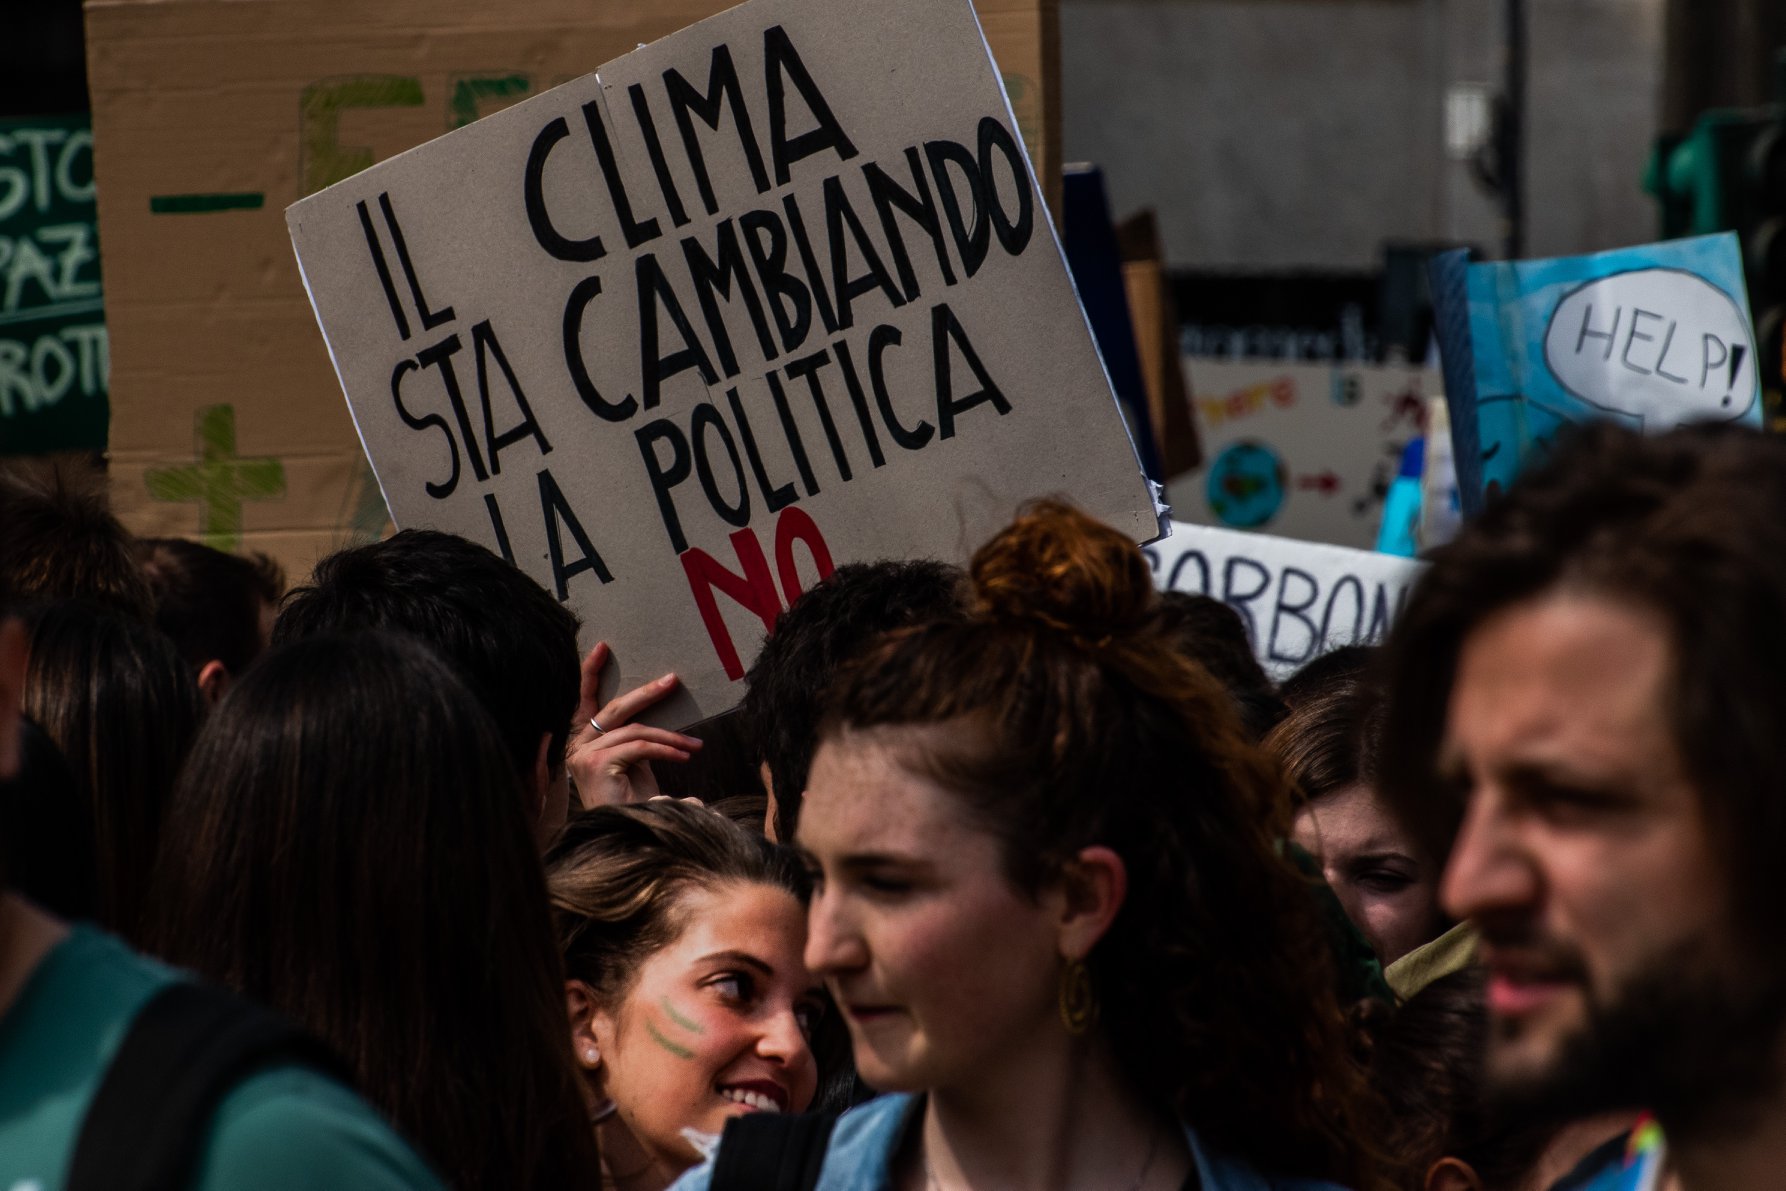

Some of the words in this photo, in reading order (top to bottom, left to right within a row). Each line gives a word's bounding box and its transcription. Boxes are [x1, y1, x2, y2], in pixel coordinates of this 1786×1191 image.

[355, 190, 457, 342] IL
[524, 25, 860, 264] CLIMA
[391, 317, 554, 501] STA
[563, 116, 1035, 424] CAMBIANDO
[1575, 303, 1746, 408] HELP!
[635, 302, 1014, 556] POLITICA
[681, 507, 835, 681] NO
[1142, 549, 1407, 664] RBON
